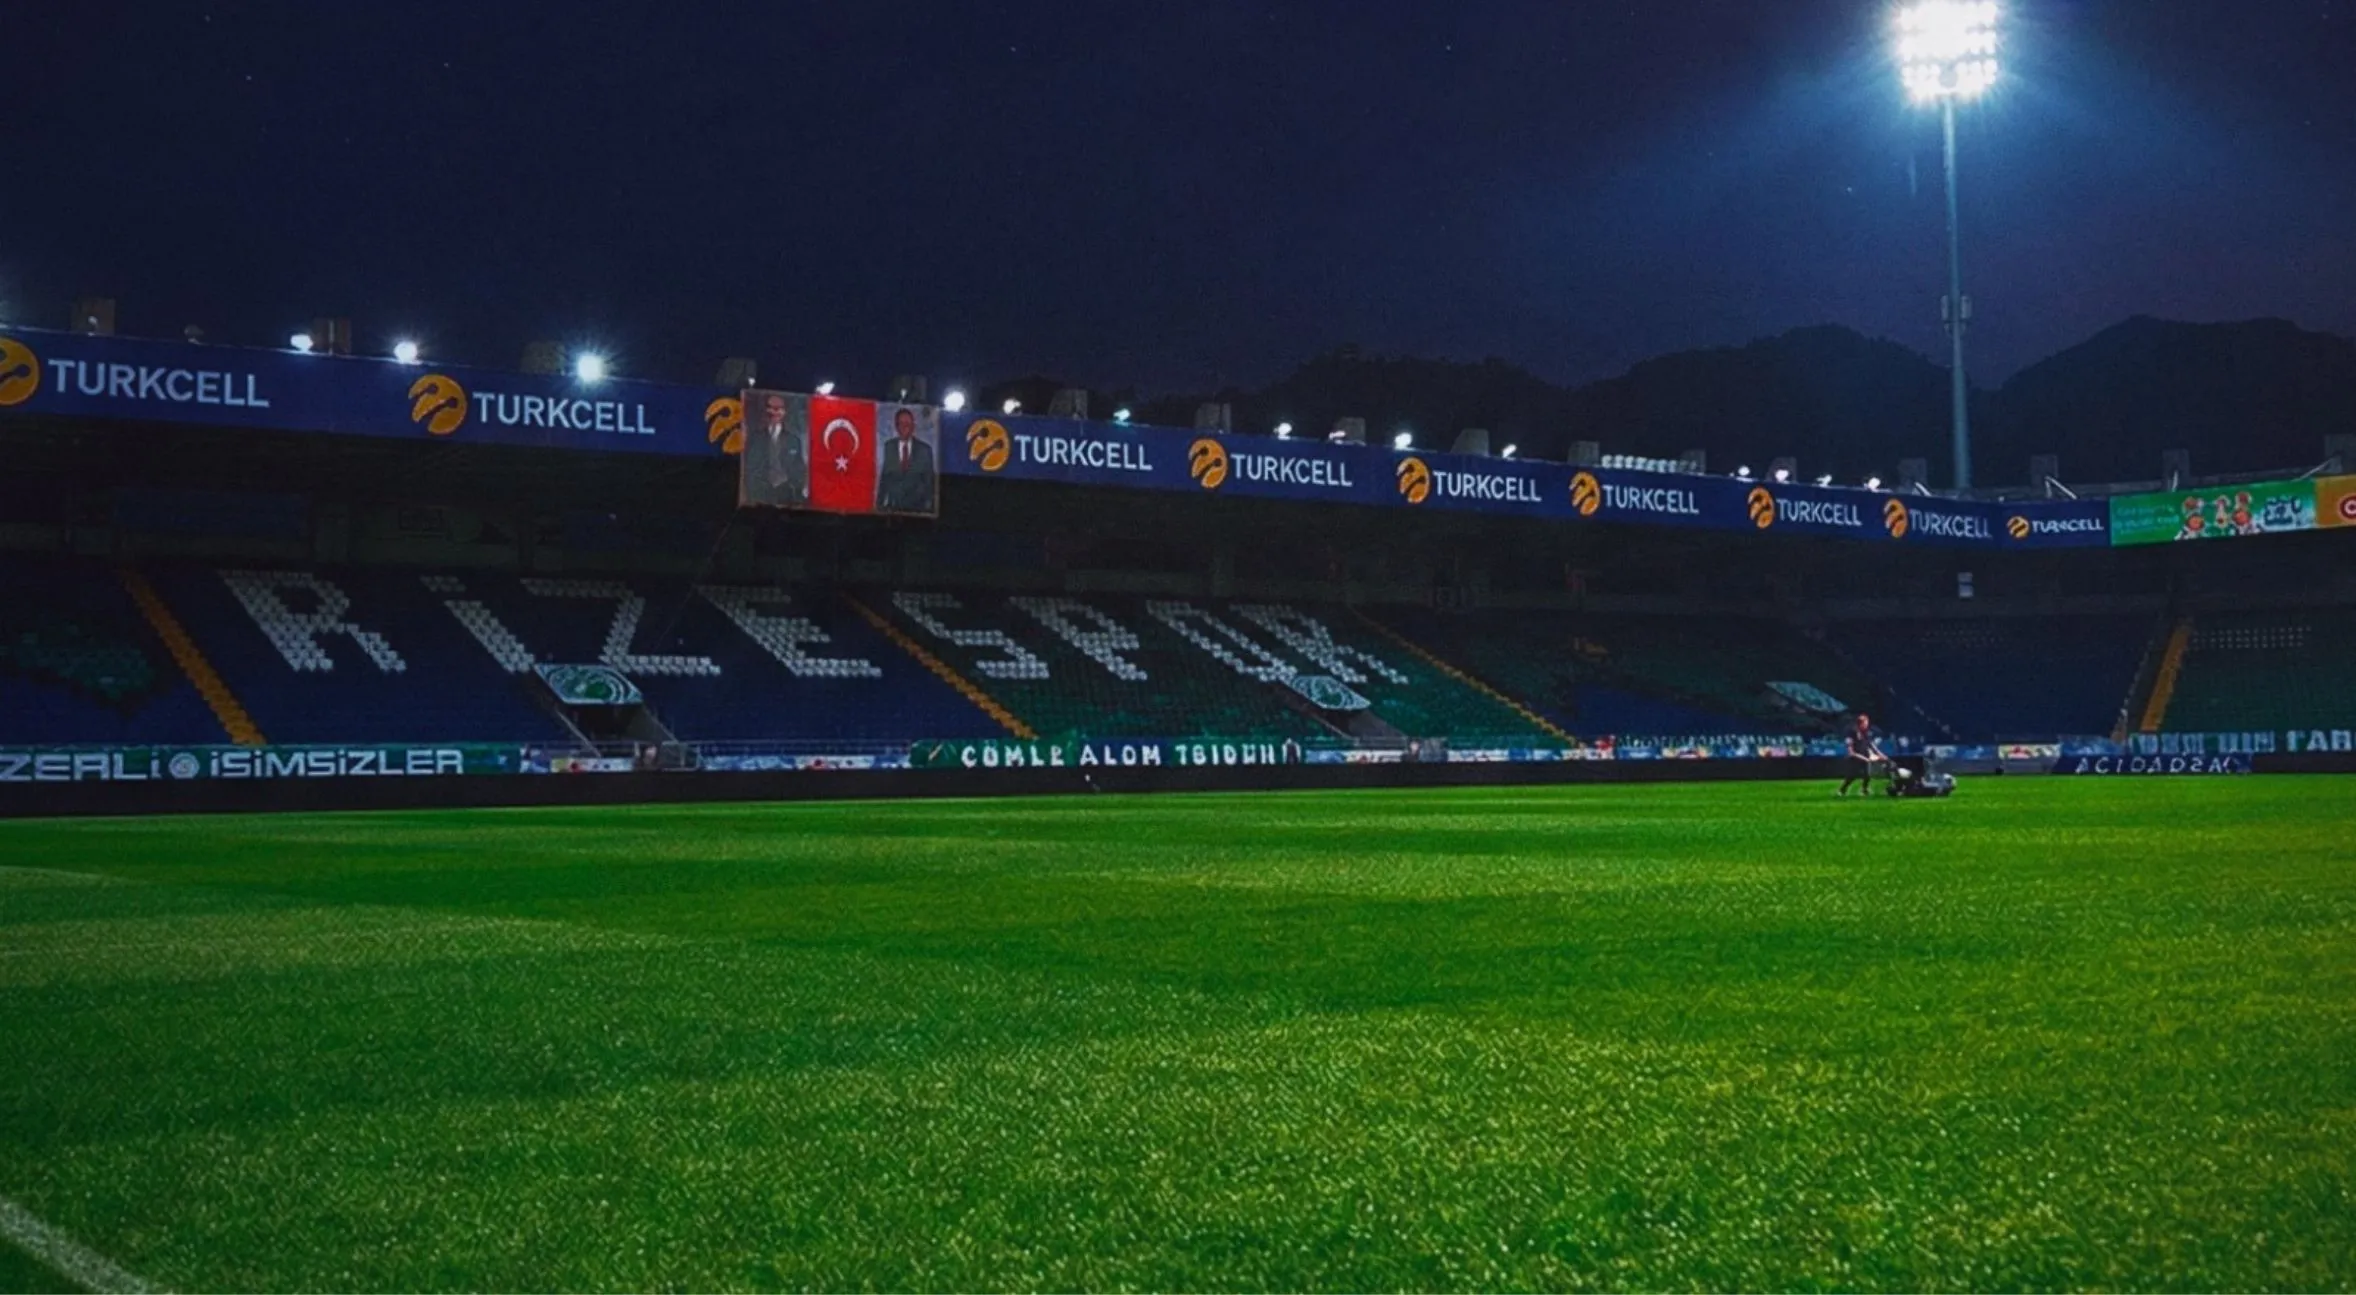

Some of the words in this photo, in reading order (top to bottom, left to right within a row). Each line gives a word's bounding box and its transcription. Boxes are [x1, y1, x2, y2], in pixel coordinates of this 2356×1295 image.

[48, 359, 269, 408] TURKCELL
[473, 391, 655, 434] TURKCELL
[1014, 434, 1153, 471] TURKCELL
[1230, 455, 1353, 487] TURKCELL
[1433, 470, 1542, 502] TURKCELL
[1602, 484, 1700, 514] TURKCELL
[1775, 498, 1863, 527] TURKCELL
[1909, 509, 1992, 539] TURKCELL
[2031, 517, 2105, 533] TURKCELL
